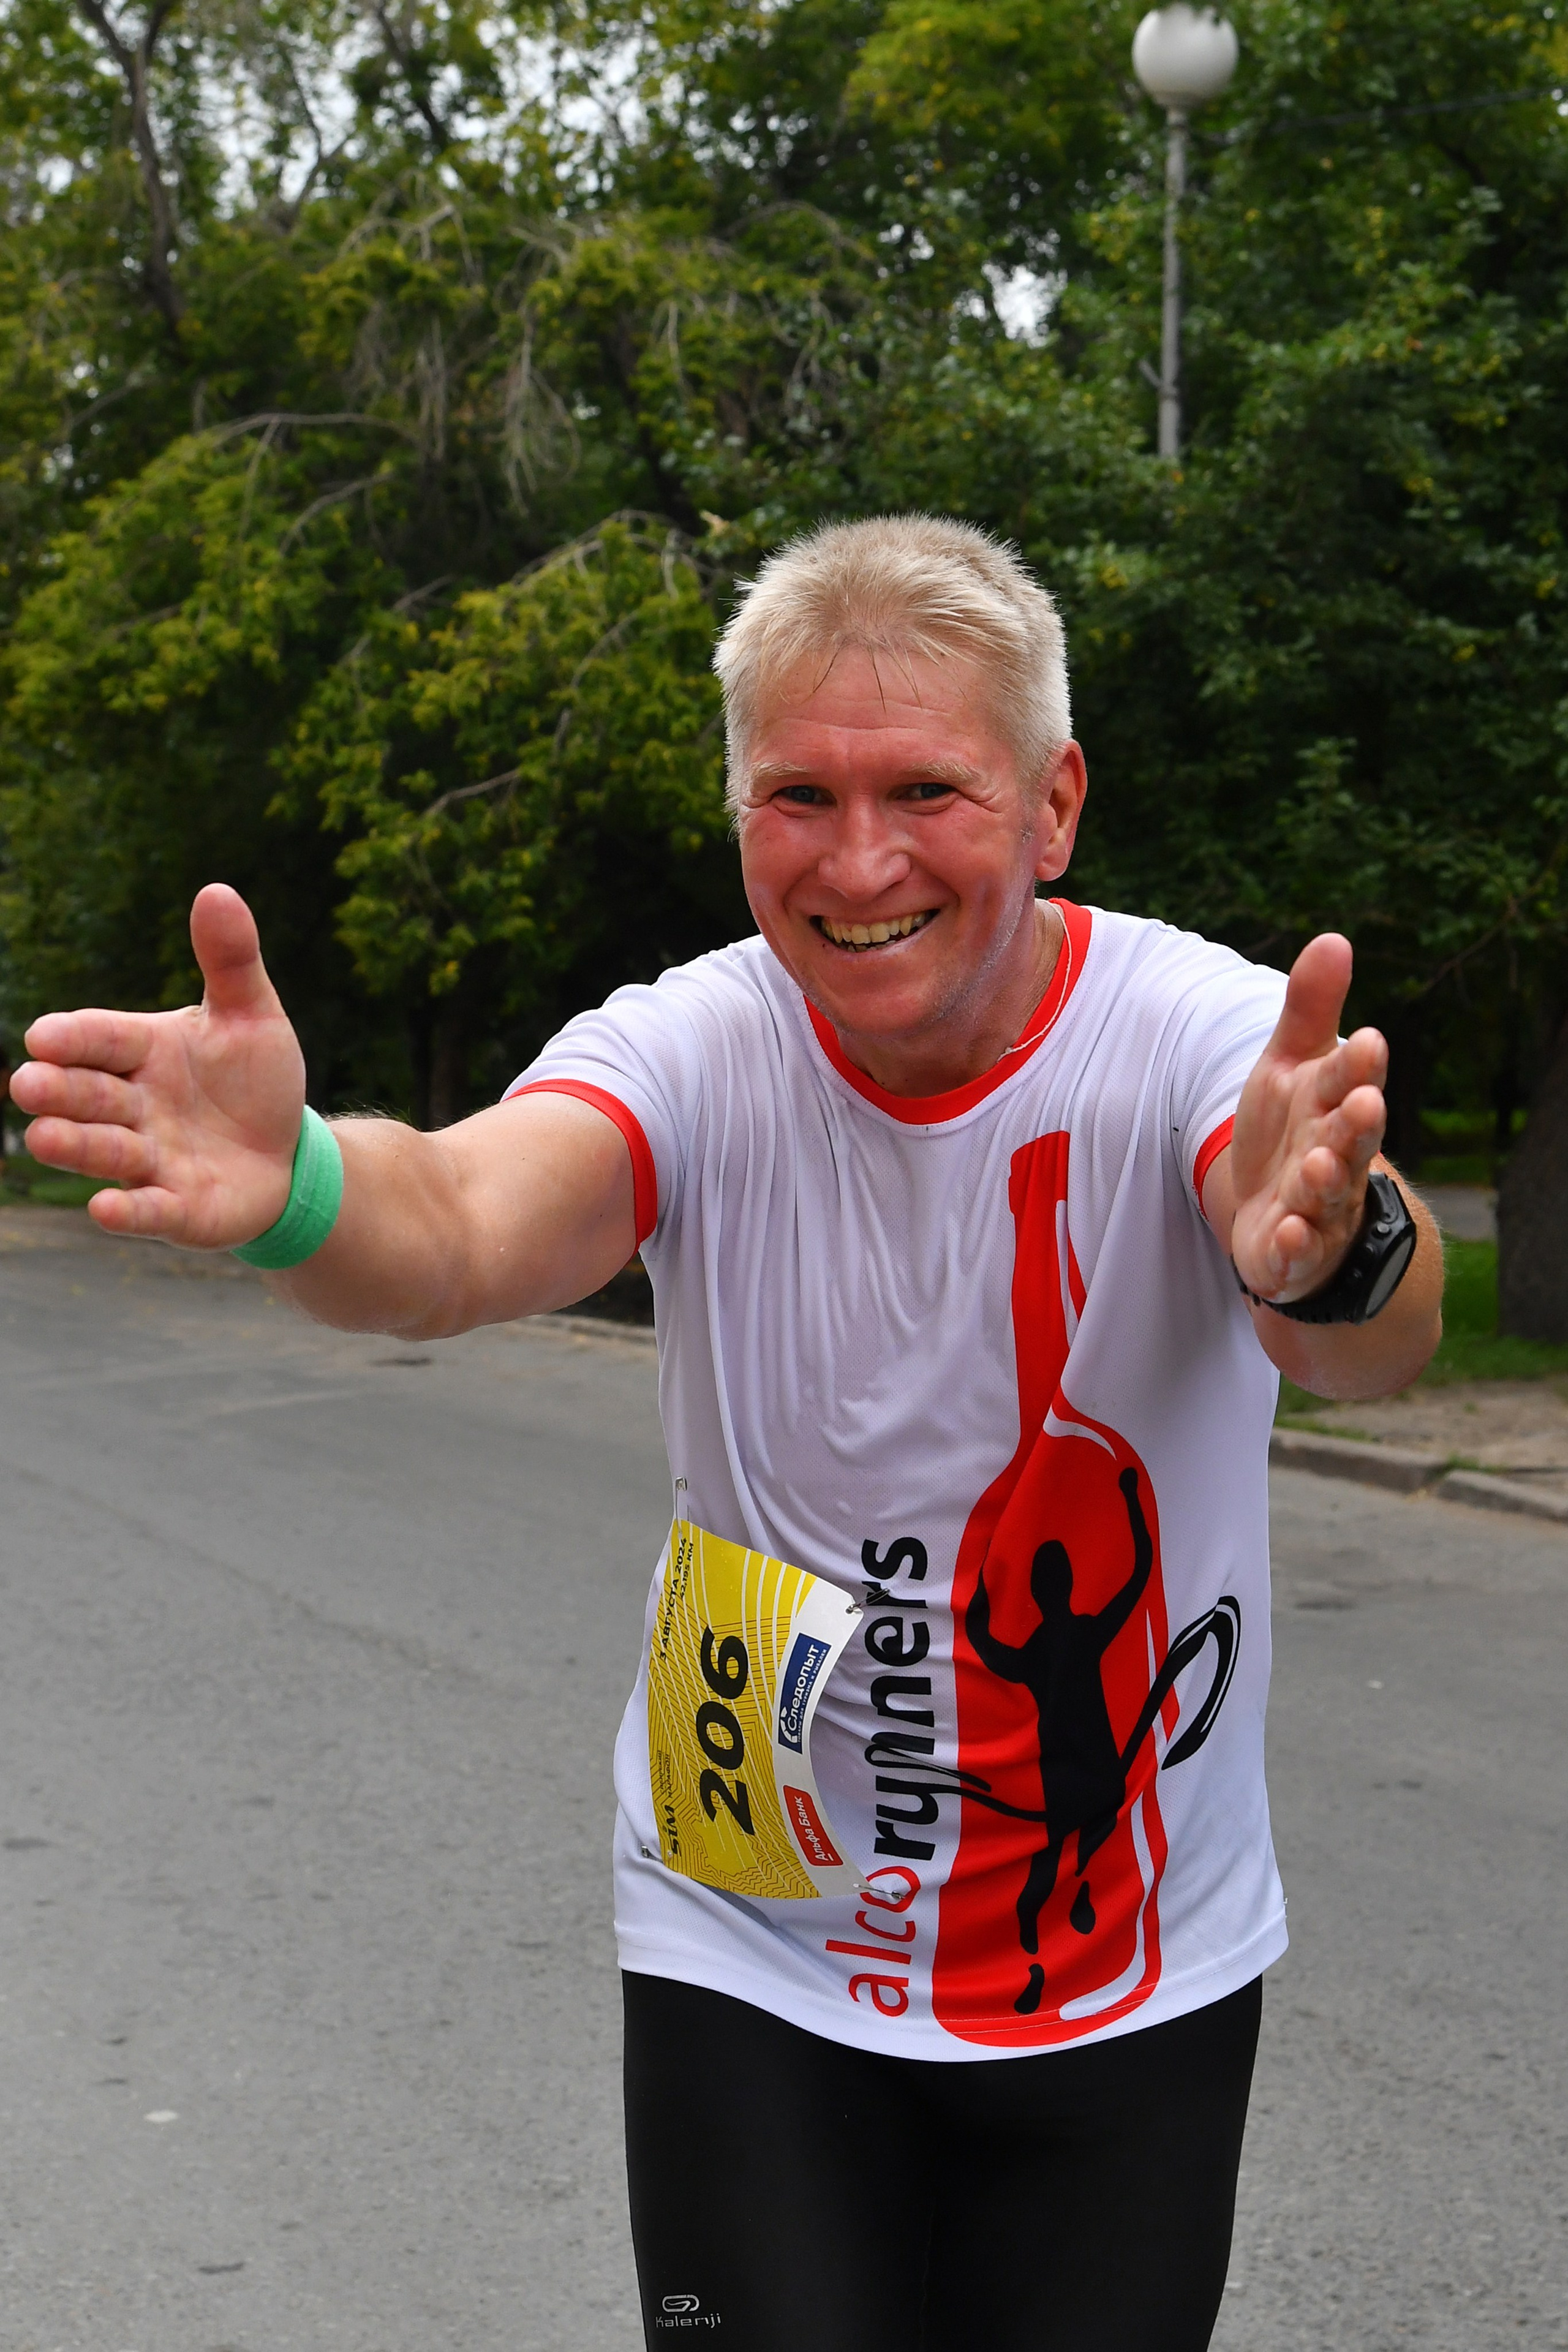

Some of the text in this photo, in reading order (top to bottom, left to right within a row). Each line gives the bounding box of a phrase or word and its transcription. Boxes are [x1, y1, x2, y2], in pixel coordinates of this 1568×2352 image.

[660, 1537, 687, 1661] 3 АВГУСТА 2024
[679, 1542, 694, 1599] 42,195 КМ
[802, 1681, 813, 1706] ТУРИЗМА
[812, 1648, 827, 1675] РЫБАЛКИ
[696, 1626, 755, 1836] 206
[794, 1796, 834, 1861] Альфа Банк
[655, 2313, 721, 2328] Kalenji
